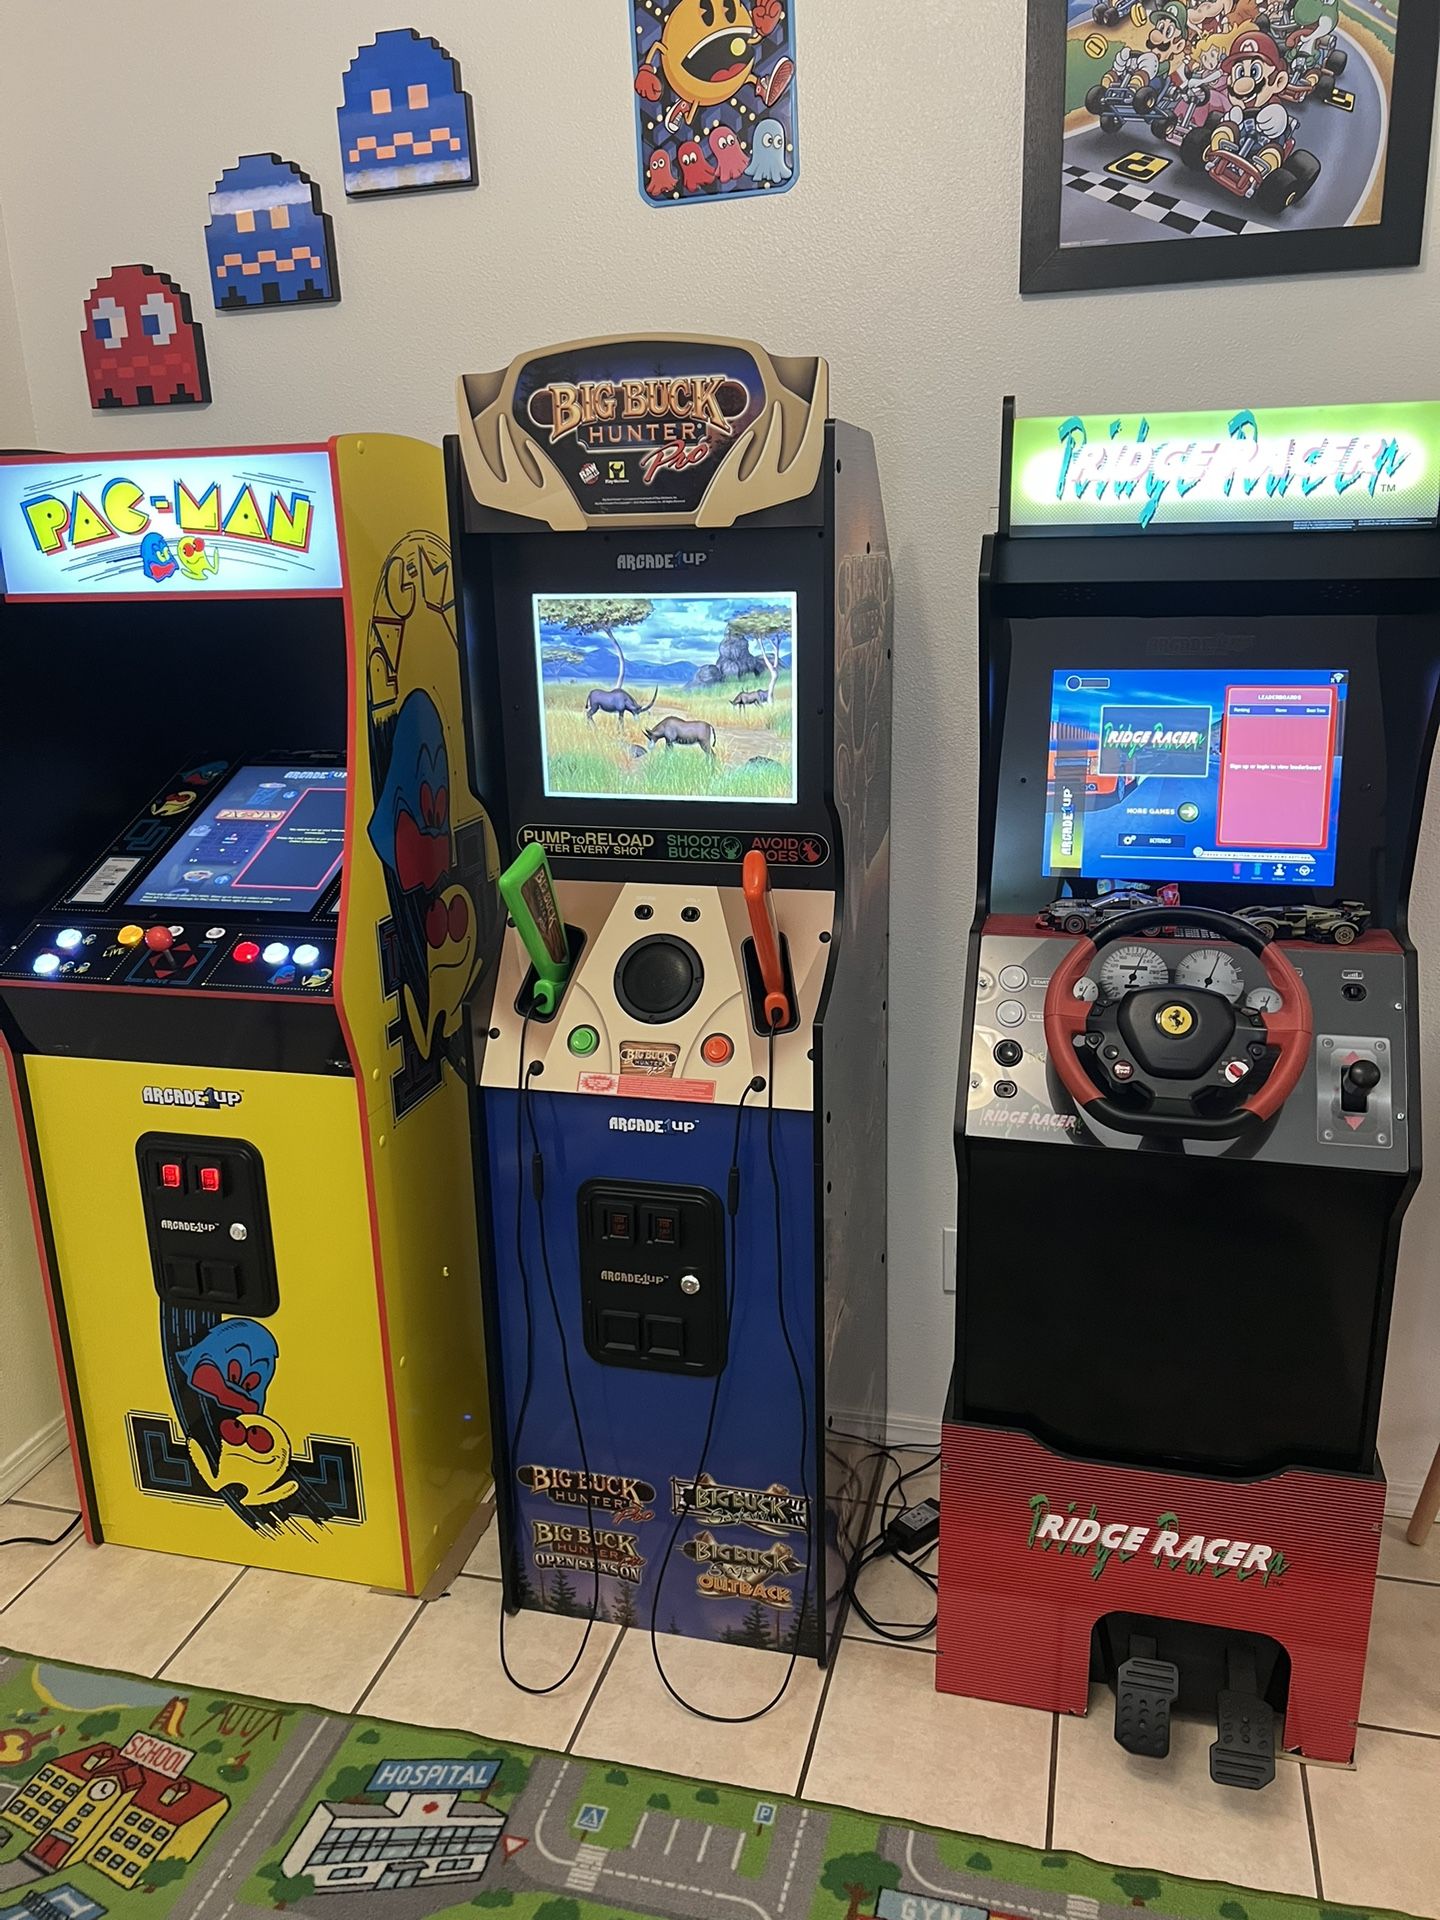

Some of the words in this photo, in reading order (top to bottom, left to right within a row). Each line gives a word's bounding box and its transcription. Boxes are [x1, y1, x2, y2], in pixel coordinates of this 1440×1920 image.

[549, 384, 616, 441] BIG
[621, 377, 733, 434] BUCK
[589, 422, 699, 443] HUNTER
[641, 439, 709, 483] Pro
[21, 477, 314, 554] PAC-MAN
[1107, 730, 1152, 744] RIDGE
[1152, 730, 1200, 745] RACER
[1126, 807, 1148, 815] MORE
[1148, 808, 1175, 816] GAMES
[523, 829, 571, 844] PUMP
[571, 835, 585, 845] TO
[585, 832, 655, 847] RELOAD
[666, 834, 721, 847] SHOOT
[751, 837, 799, 850] AVOID
[542, 843, 570, 853] FTER
[573, 844, 610, 855] EVERY
[613, 845, 645, 856] SHOT
[668, 847, 721, 860] BUCKS
[764, 850, 799, 862] OES
[102, 947, 126, 957] LIVE
[983, 1109, 1029, 1125] RIDGE
[1029, 1112, 1078, 1128] RACER
[532, 1466, 573, 1494] BIG
[695, 1487, 731, 1509] BIG
[732, 1491, 788, 1521] BUCK
[534, 1522, 574, 1547] BIG
[578, 1528, 640, 1558] BUCK
[1036, 1513, 1150, 1552] RIDGE
[1150, 1530, 1274, 1572] RACER
[535, 1553, 576, 1569] OPEN
[695, 1540, 732, 1562] BIG
[734, 1545, 791, 1576] BUCK
[697, 1574, 793, 1601] OUTBACK
[125, 1735, 188, 1775] SCHOOL
[376, 1765, 488, 1787] HOSPITAL
